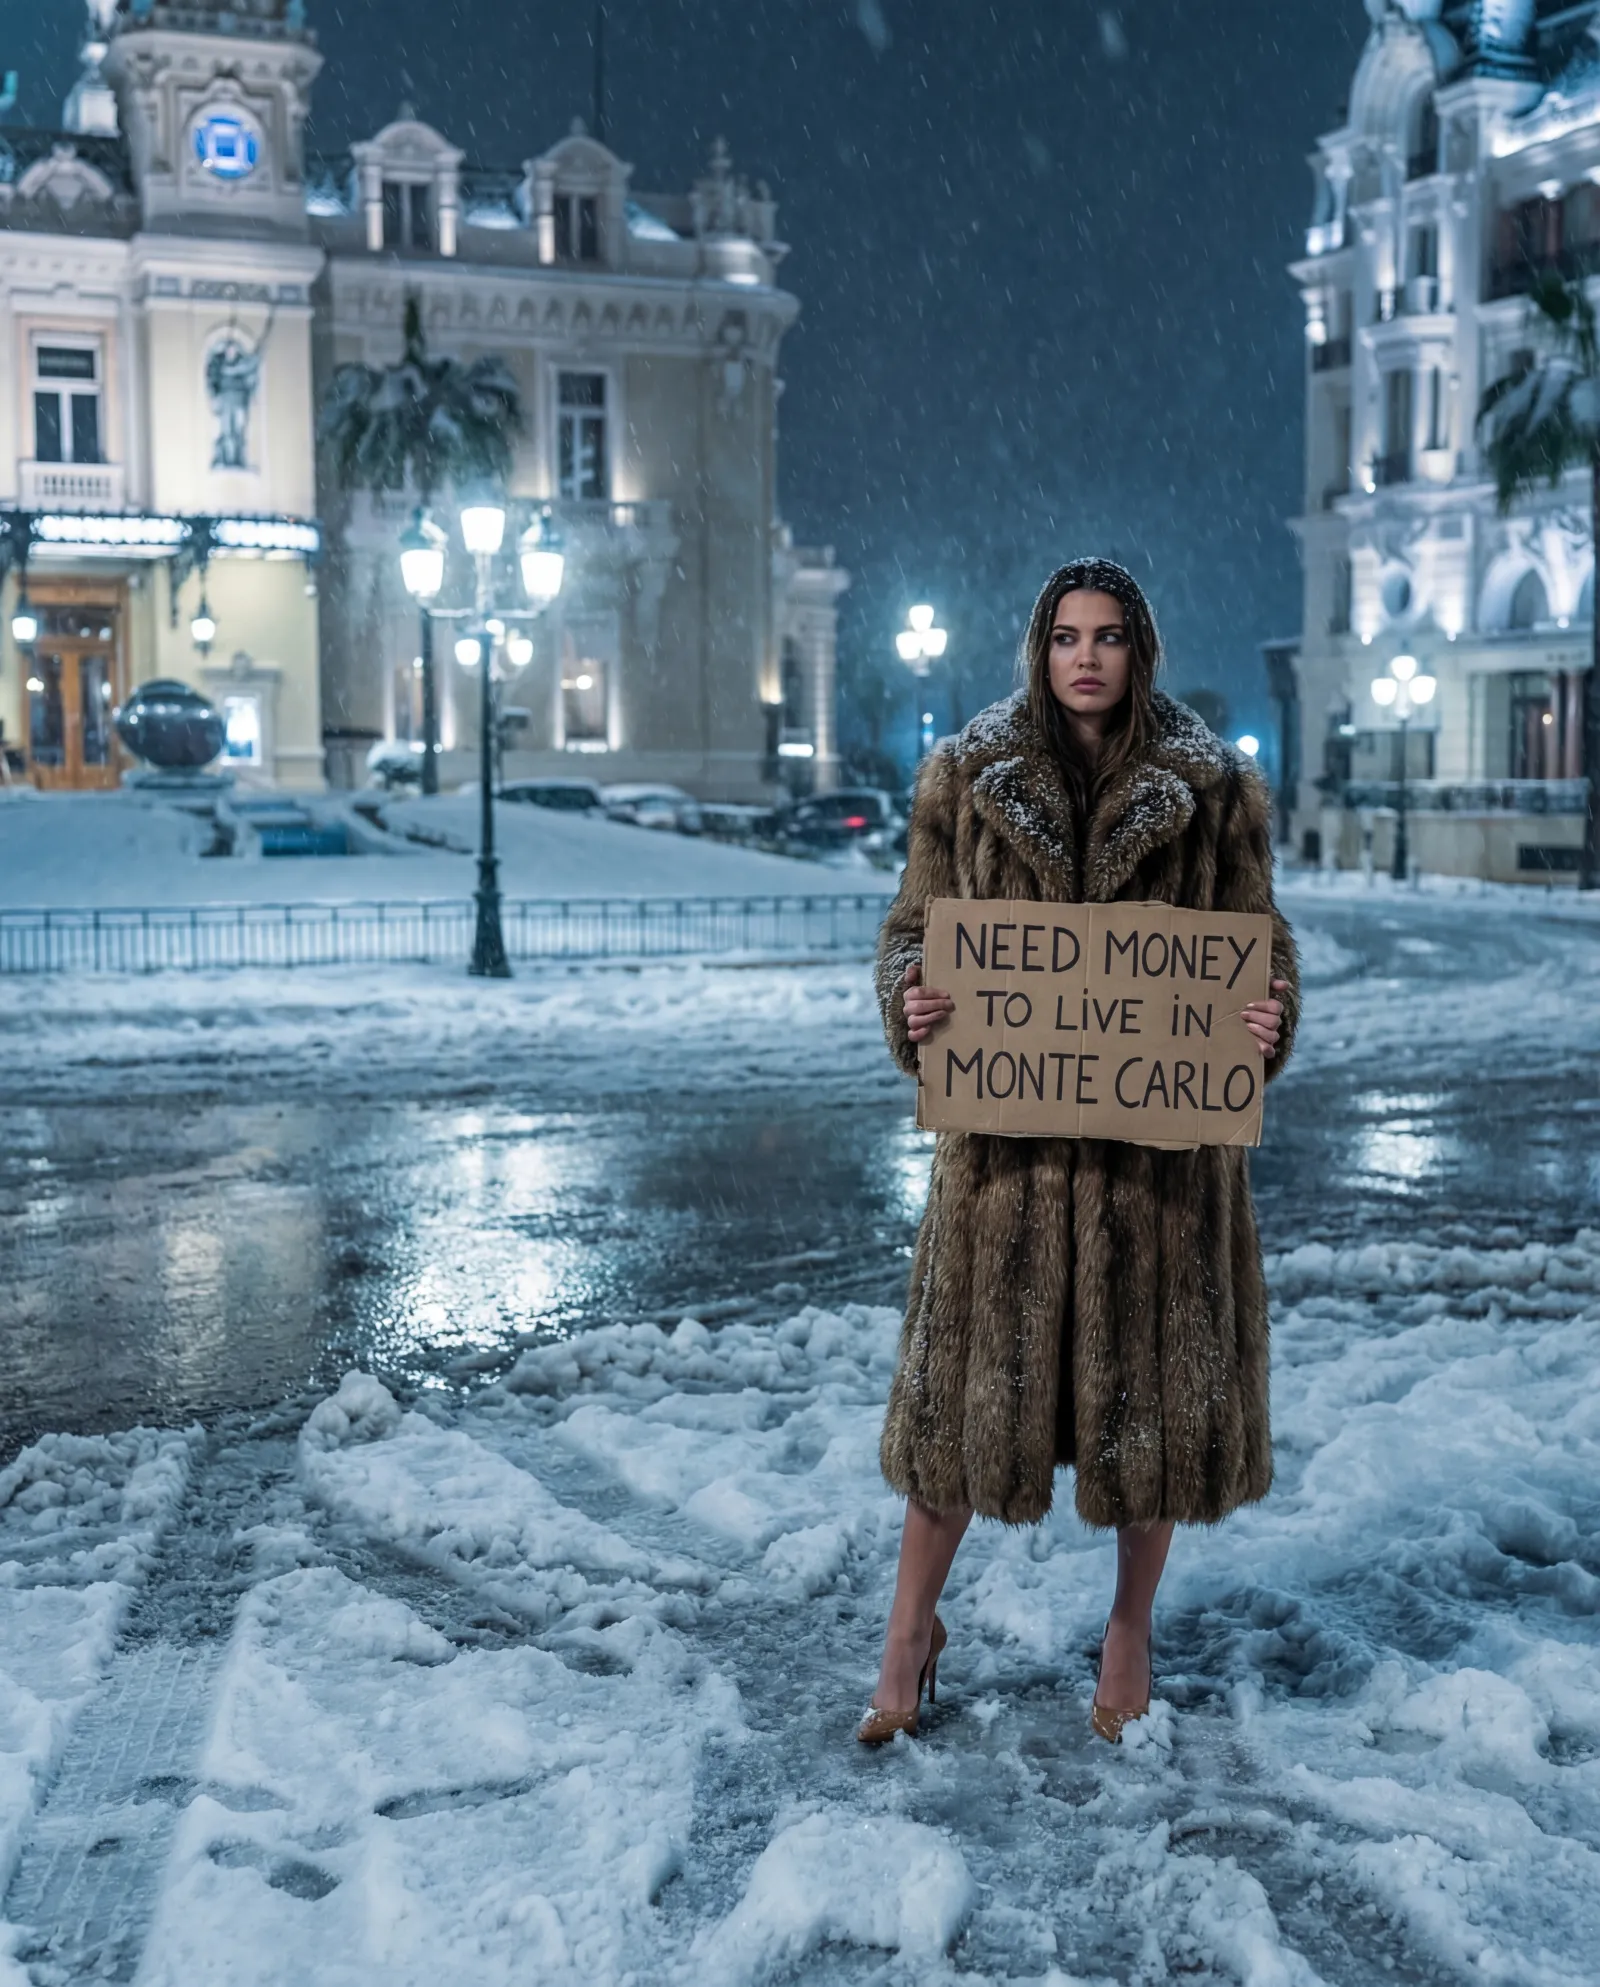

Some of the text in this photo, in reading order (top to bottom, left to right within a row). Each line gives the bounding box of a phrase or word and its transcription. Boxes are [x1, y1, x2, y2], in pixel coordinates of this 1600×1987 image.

[955, 922, 1257, 990] NEED MONEY
[976, 990, 1032, 1028] TO
[945, 1047, 1256, 1112] MONTE CARLO
